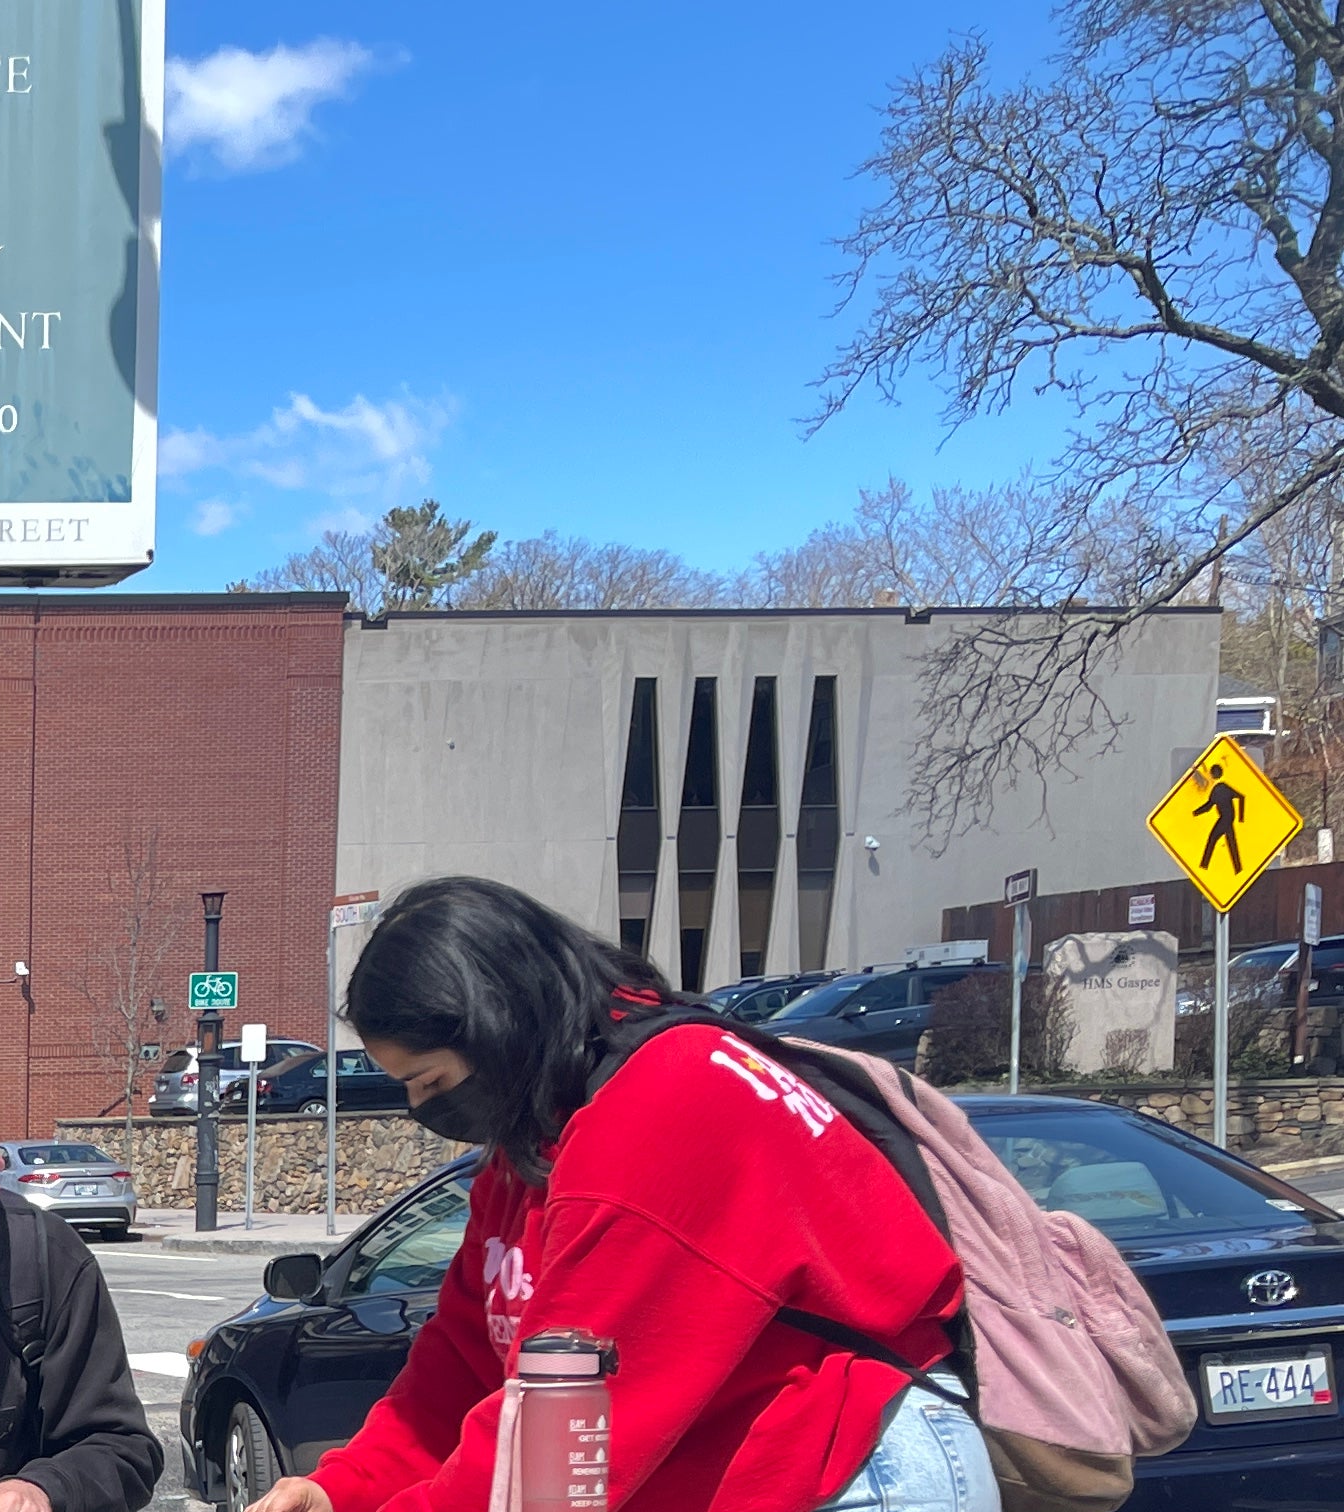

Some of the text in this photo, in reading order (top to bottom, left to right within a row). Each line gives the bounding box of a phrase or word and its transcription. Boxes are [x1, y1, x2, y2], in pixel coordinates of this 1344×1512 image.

[1083, 976, 1161, 990] HMS Gaspee
[1219, 1363, 1316, 1406] RE-444
